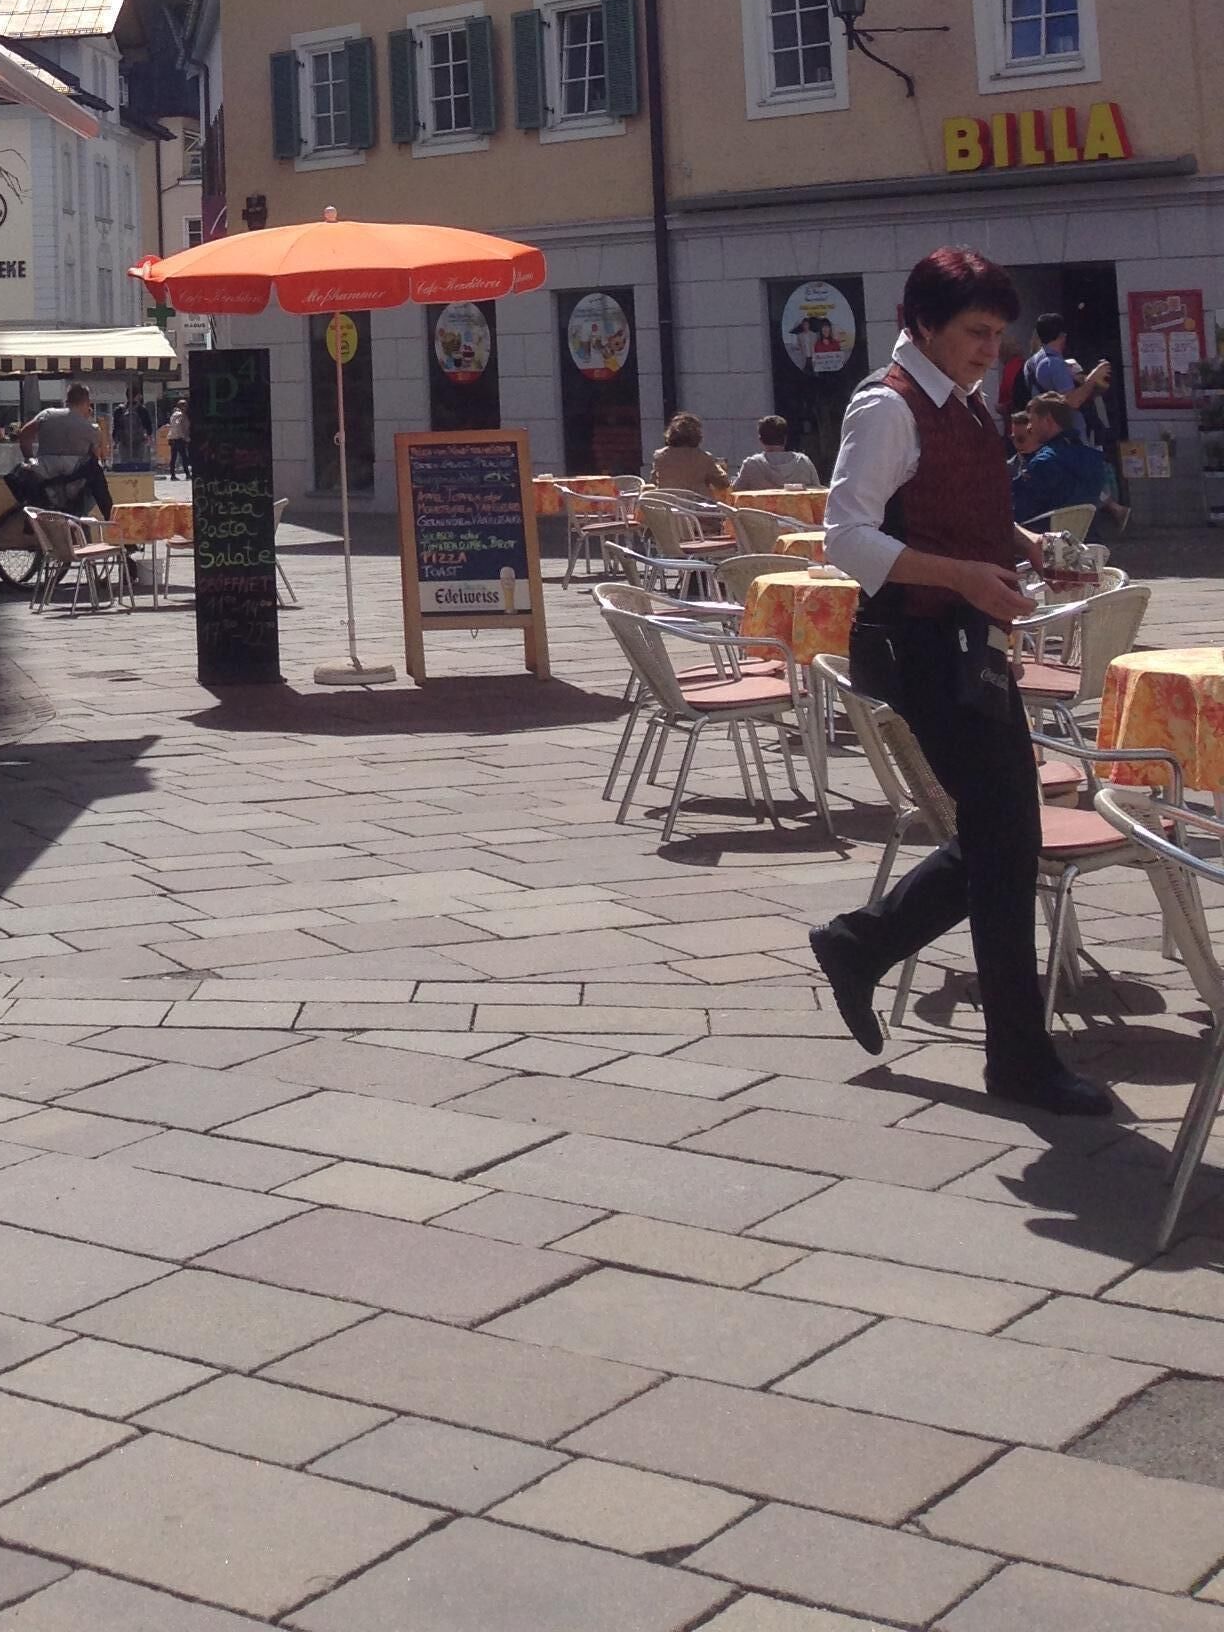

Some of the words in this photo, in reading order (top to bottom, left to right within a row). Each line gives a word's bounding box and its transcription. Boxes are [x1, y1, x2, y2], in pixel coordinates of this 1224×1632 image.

[942, 101, 1133, 173] BILLA
[195, 496, 264, 518] Pizza
[197, 517, 259, 538] Pasta
[198, 541, 276, 568] Salate
[421, 551, 468, 564] PIZZA
[422, 564, 464, 578] TOAST
[435, 587, 500, 604] Edelweiss
